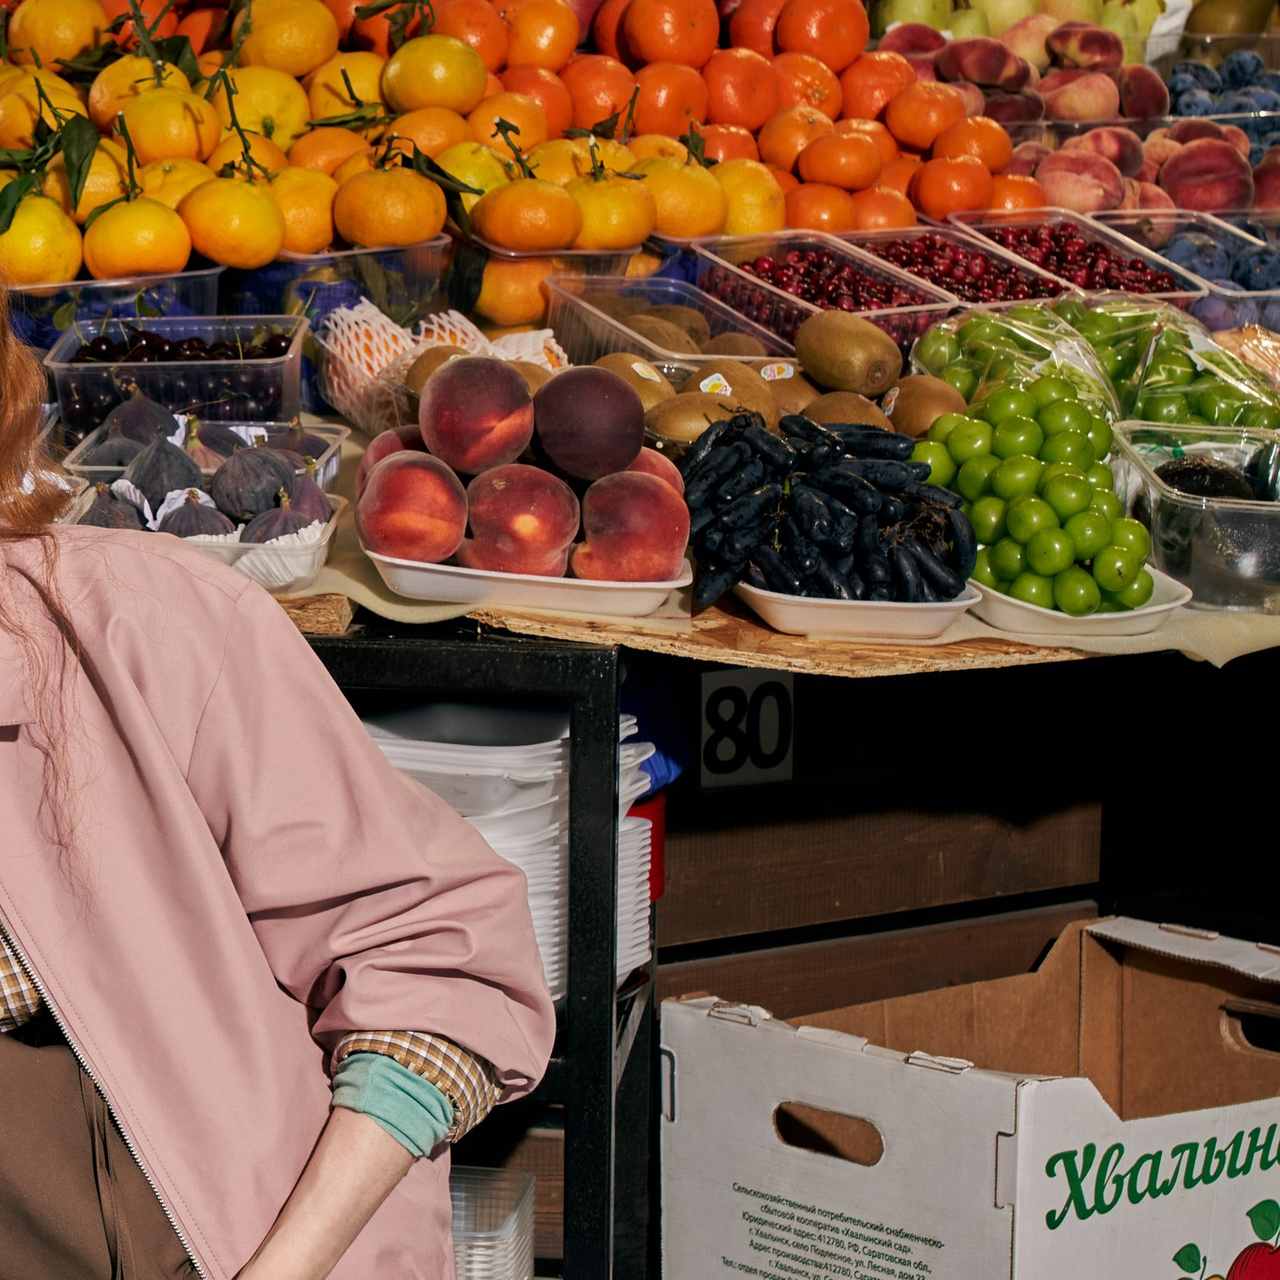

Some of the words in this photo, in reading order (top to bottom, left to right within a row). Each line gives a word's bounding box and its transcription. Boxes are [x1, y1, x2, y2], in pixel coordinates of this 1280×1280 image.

[703, 681, 792, 774] 80
[1045, 1123, 1280, 1230] Хвалын
[732, 1182, 816, 1214] Сельскохозяйственный
[817, 1208, 884, 1233] потребительский
[885, 1227, 945, 1249] снабженческо-
[760, 1204, 795, 1222] сбытовой
[796, 1215, 840, 1234] кооператив
[841, 1227, 892, 1249] «Хвалынский
[742, 1211, 792, 1234] Юридический
[818, 1234, 846, 1251] 412780,
[848, 1241, 861, 1255] РФ,
[862, 1246, 912, 1267] Саратовская
[913, 1261, 932, 1274] обл.,
[749, 1240, 771, 1254] Адрес
[755, 1228, 791, 1247] Хвалынск,
[792, 1240, 809, 1252] село
[810, 1244, 853, 1266] Подлесное,
[867, 1260, 897, 1278] Лесная,
[738, 1263, 758, 1276] отдел
[774, 1260, 811, 1280] Хвалынск,
